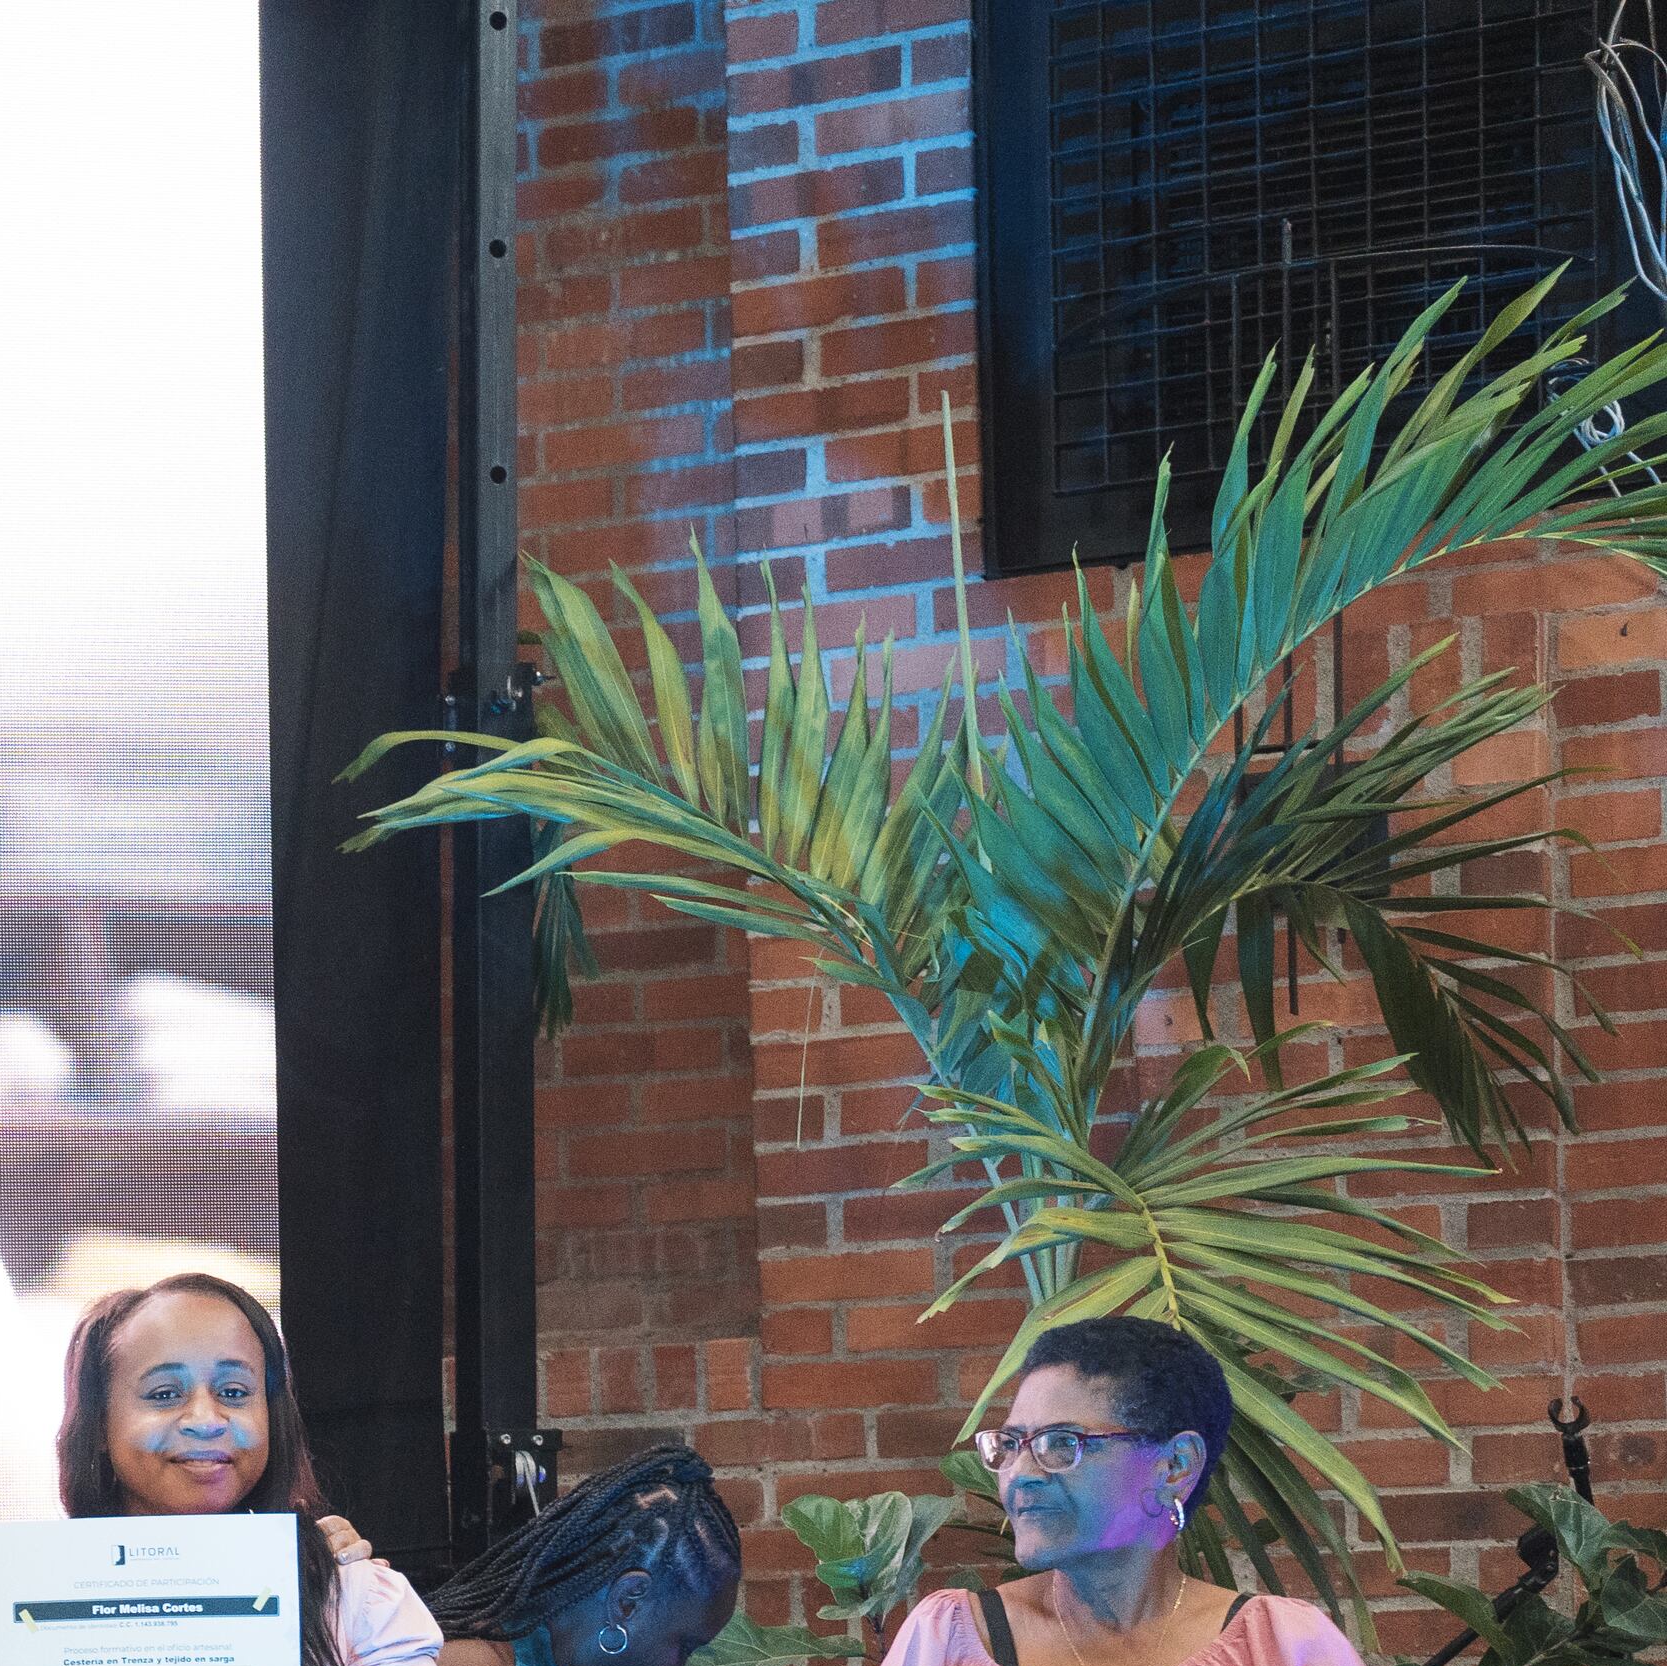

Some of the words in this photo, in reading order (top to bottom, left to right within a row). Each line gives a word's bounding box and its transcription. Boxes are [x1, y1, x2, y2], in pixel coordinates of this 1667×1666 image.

[129, 1547, 179, 1556] LITORAL
[74, 1579, 134, 1588] CERTIFICADO
[92, 1604, 116, 1614] Flor
[119, 1603, 159, 1613] Melisa
[162, 1602, 203, 1612] Cortes
[121, 1656, 153, 1664] Trenza
[165, 1655, 191, 1664] tejido
